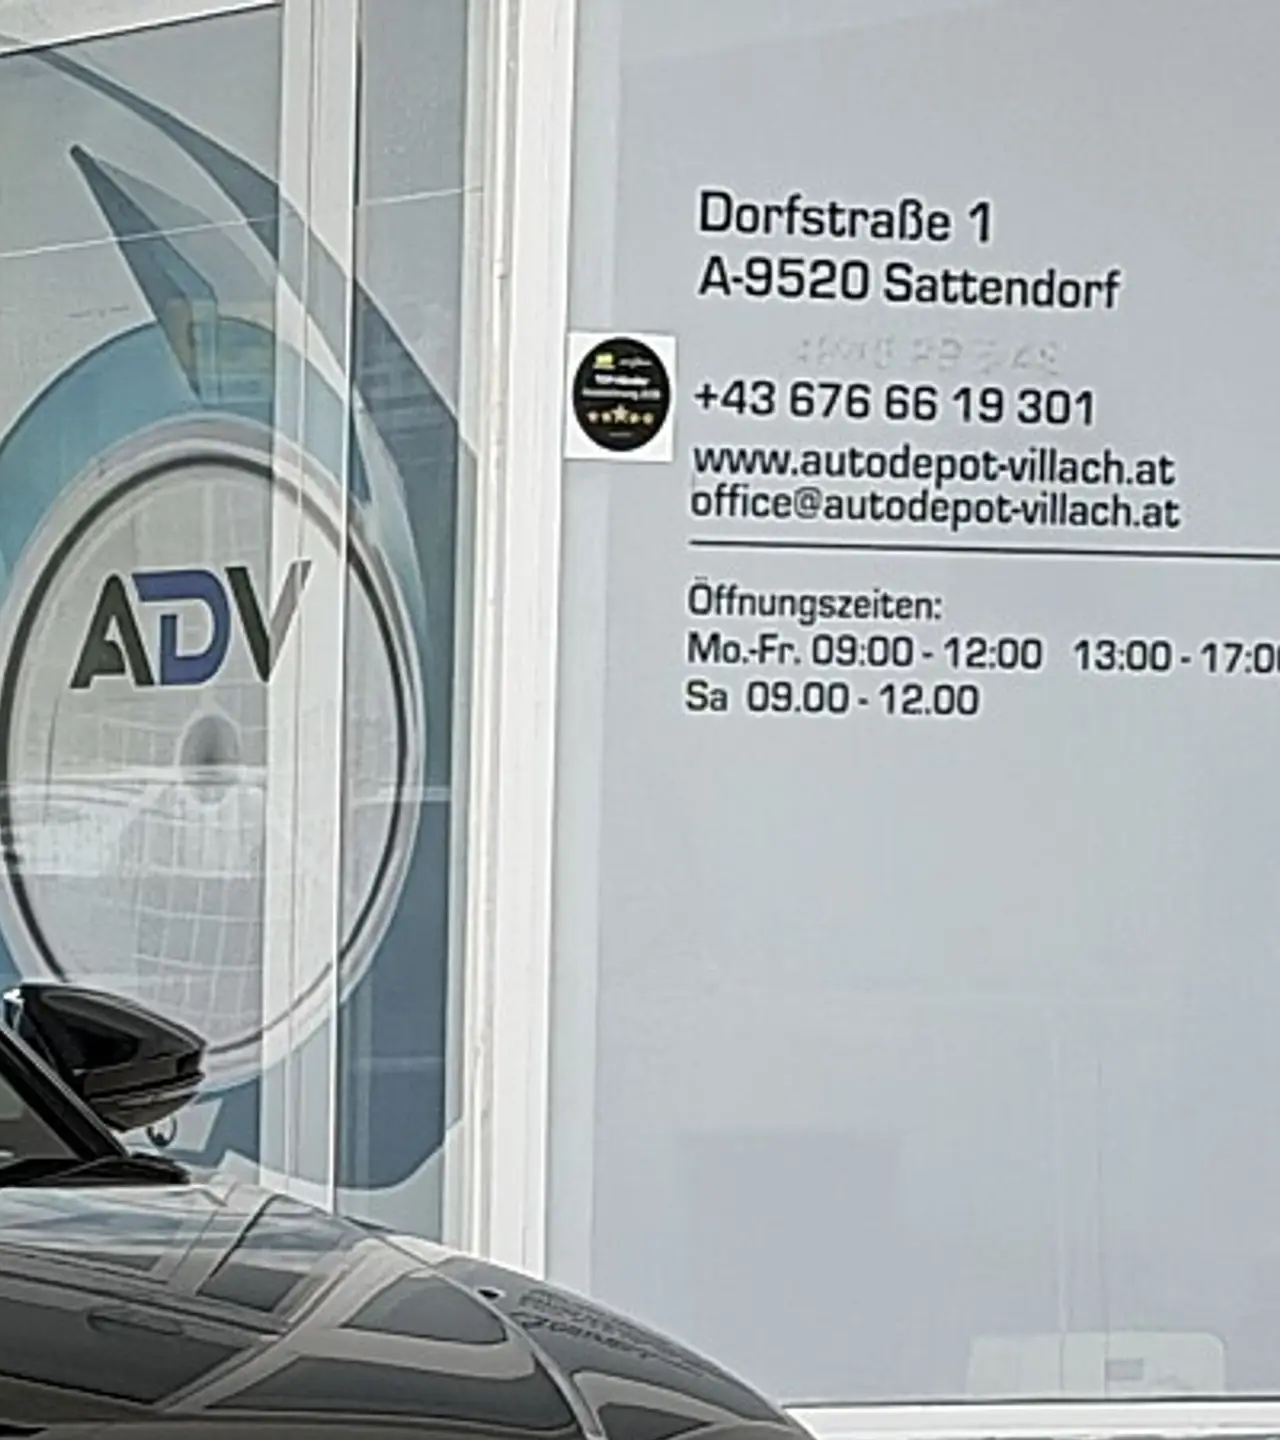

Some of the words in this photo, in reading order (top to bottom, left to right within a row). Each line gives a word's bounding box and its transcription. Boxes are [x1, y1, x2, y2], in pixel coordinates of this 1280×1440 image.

[700, 190, 951, 241] Dorfstraße
[969, 201, 990, 243] 1
[699, 255, 870, 300] A-9520
[883, 262, 1121, 309] Sattendorf
[693, 379, 777, 415] +43
[790, 381, 872, 419] 676
[885, 384, 938, 421] 66
[953, 386, 1004, 423] 19
[1017, 389, 1093, 426] 301
[694, 442, 1176, 490] www.autodepot-villach.at
[691, 482, 1181, 533] office@autodepot-villach.at
[69, 561, 312, 688] ADV
[688, 575, 942, 626] Öffnungszeiten:
[688, 631, 801, 664] Mo.-Fr.
[812, 634, 914, 667] 09:00
[944, 636, 1043, 670] 12:00
[1074, 639, 1172, 671] 13:00
[685, 680, 728, 711] Sa
[748, 681, 850, 713] 09.00
[880, 683, 979, 715] 12.00
